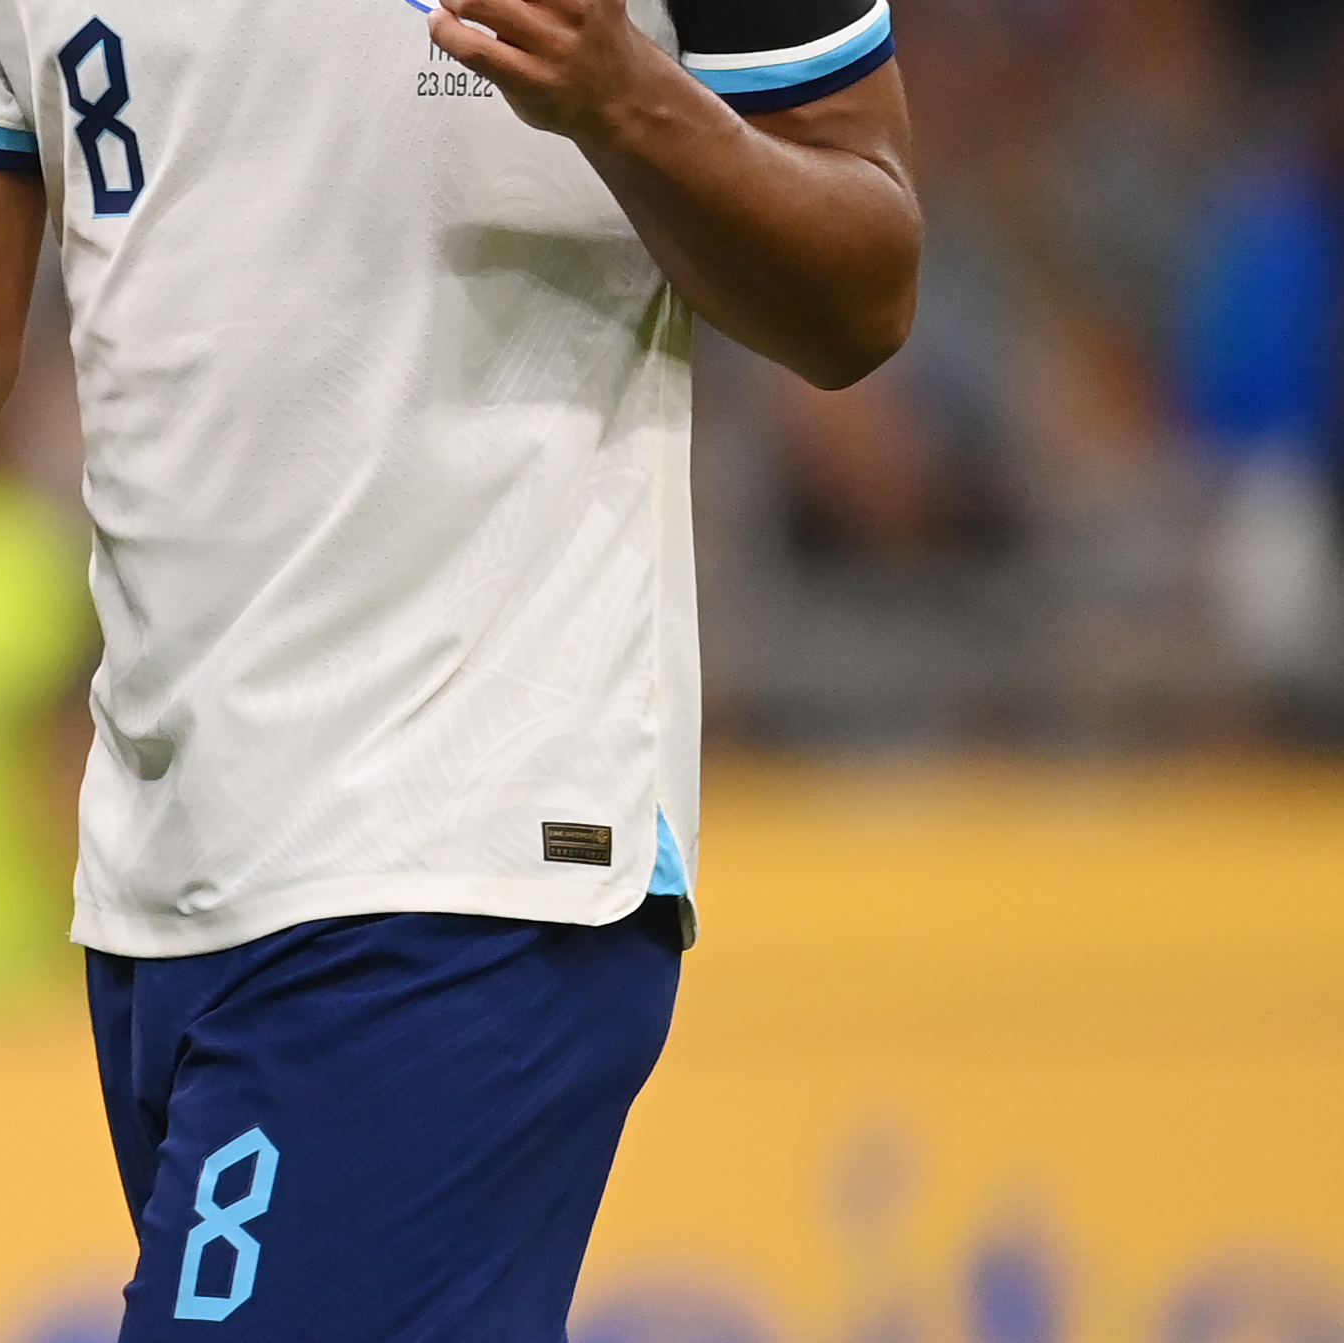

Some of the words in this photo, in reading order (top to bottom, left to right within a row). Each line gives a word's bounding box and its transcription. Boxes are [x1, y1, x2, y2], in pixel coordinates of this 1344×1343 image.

[57, 14, 145, 219] 8
[417, 72, 493, 97] 23.09.22
[173, 1126, 280, 1322] 8
